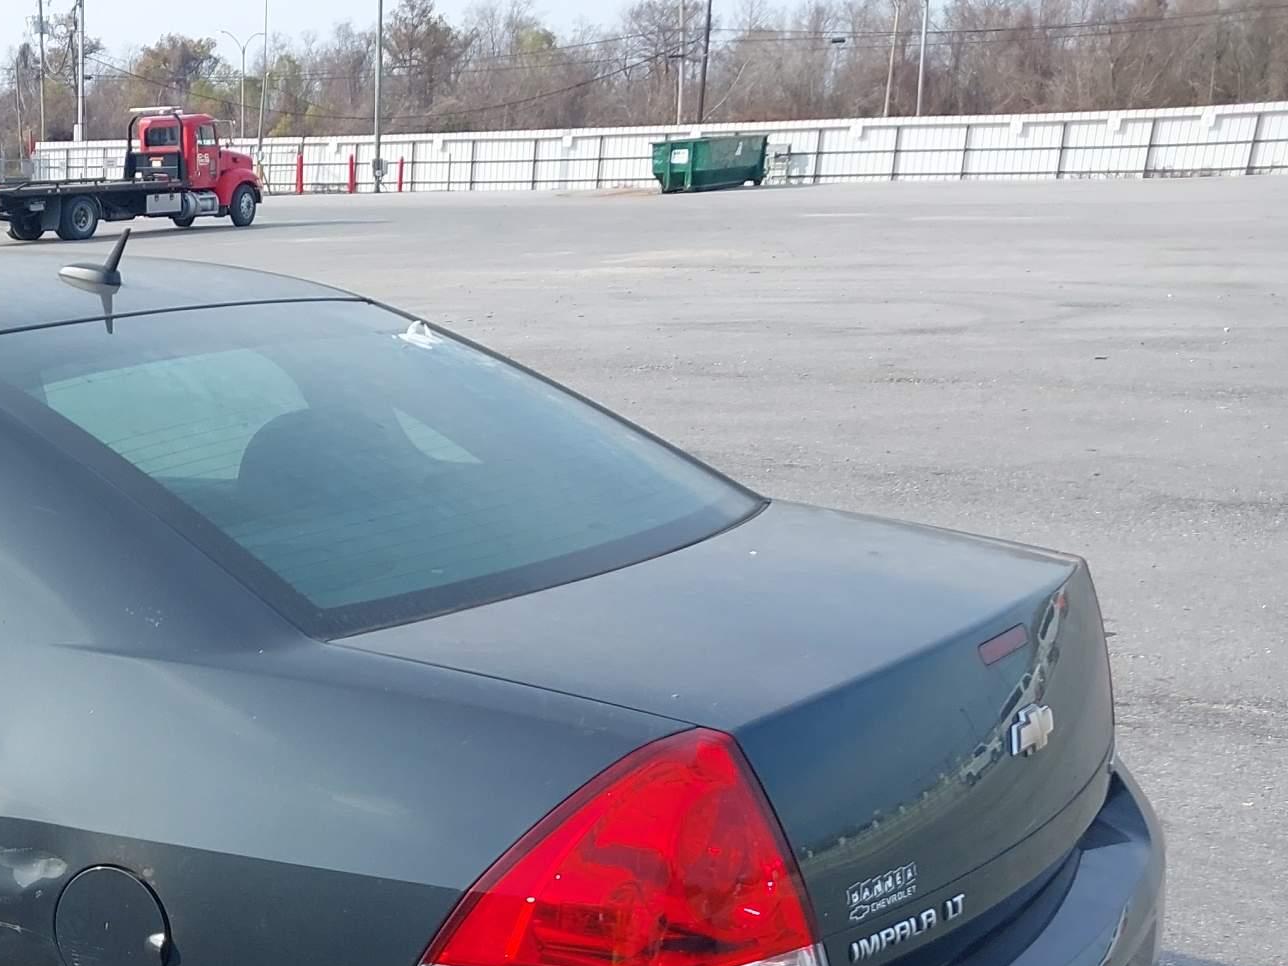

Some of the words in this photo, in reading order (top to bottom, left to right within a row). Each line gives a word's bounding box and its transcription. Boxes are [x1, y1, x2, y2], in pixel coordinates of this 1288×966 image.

[870, 884, 917, 912] CHEVROLET
[946, 893, 965, 921] LT
[851, 908, 937, 962] IMPALA
